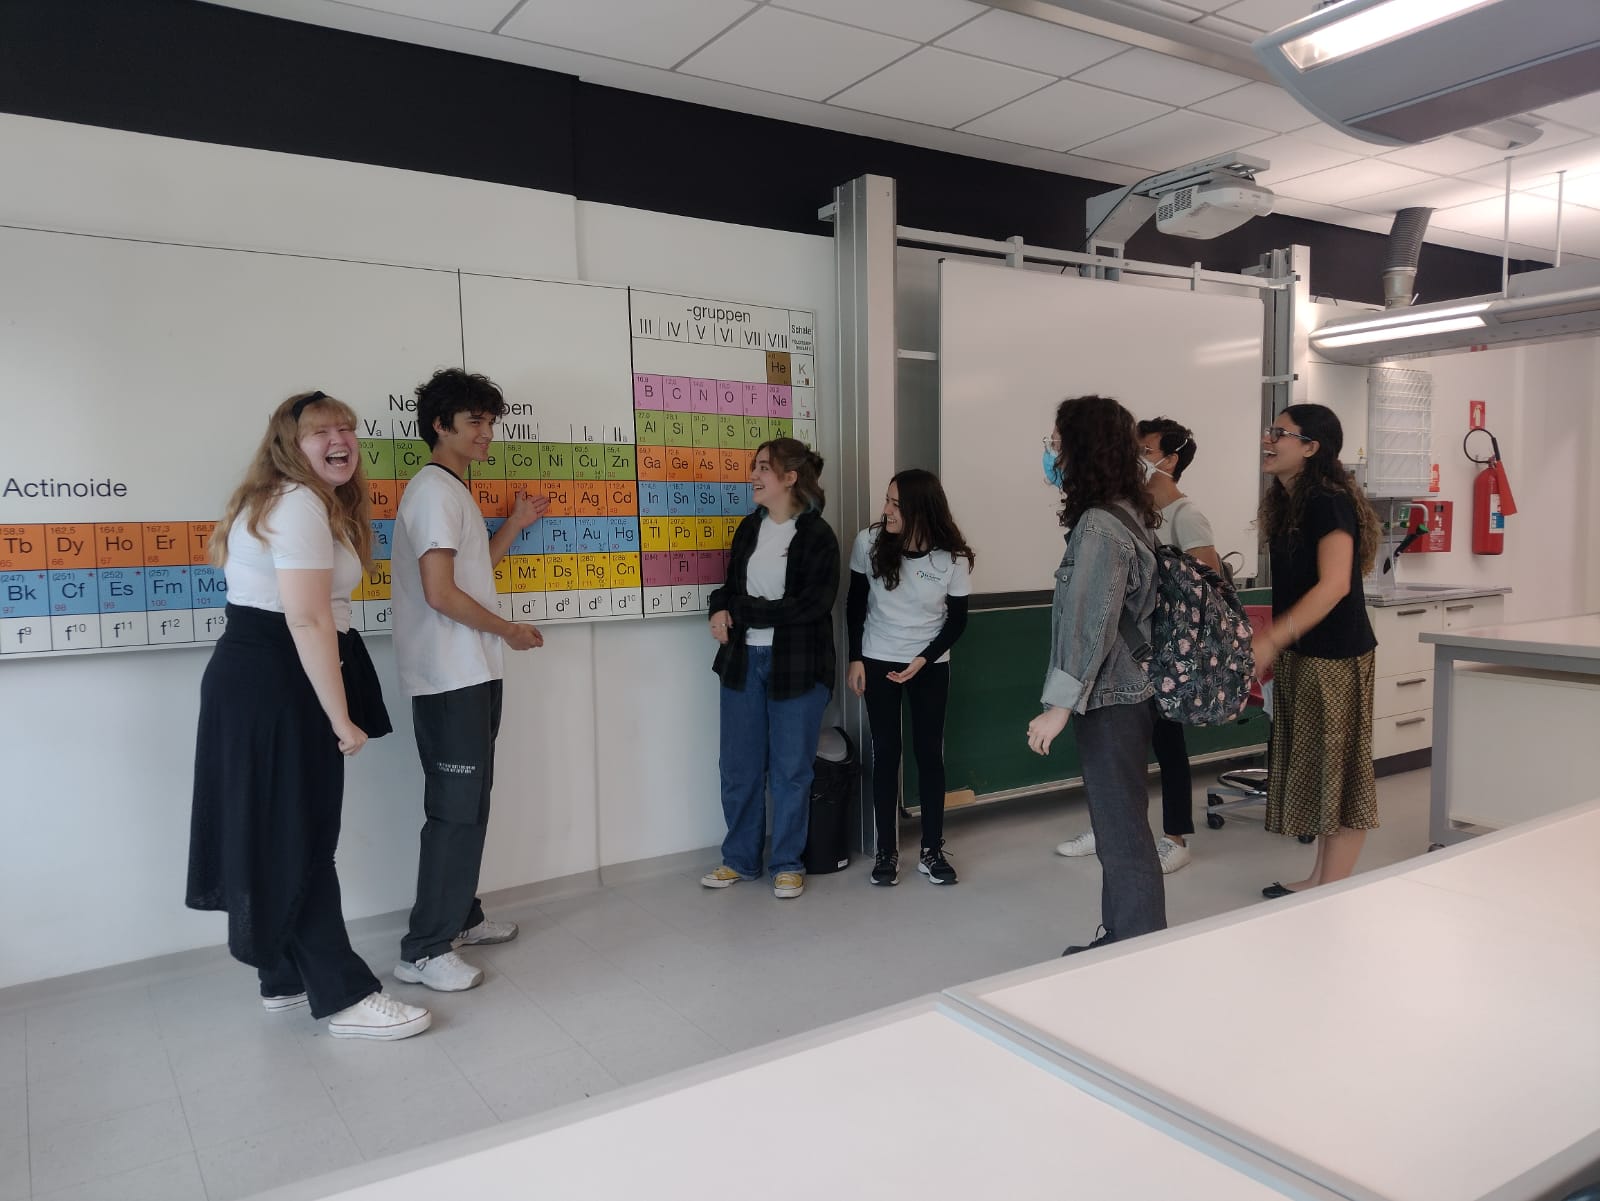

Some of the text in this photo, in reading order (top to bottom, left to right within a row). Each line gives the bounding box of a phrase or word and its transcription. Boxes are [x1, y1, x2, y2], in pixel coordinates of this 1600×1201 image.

[686, 305, 751, 324] -gruppen
[640, 319, 651, 335] III
[667, 321, 681, 337] IV
[696, 325, 706, 340] V
[791, 324, 812, 335] Schale
[720, 328, 733, 343] VI
[744, 331, 761, 346] VII
[768, 333, 788, 349] VIII
[772, 361, 786, 374] He
[799, 363, 806, 375] K
[645, 385, 653, 397] B
[672, 387, 681, 400] C
[700, 389, 708, 401] N
[725, 391, 734, 403] O
[752, 393, 758, 405] F
[773, 394, 787, 407] Ne
[645, 421, 656, 433] Al
[673, 422, 684, 435] Si
[701, 424, 709, 435] P
[727, 425, 735, 437] S
[750, 427, 761, 438] Cl
[776, 428, 786, 439] Ar
[368, 451, 380, 465] V
[403, 452, 422, 466] Cr
[512, 453, 533, 467] Co
[549, 454, 563, 467] Ni
[579, 454, 598, 468] Cu
[612, 455, 629, 468] Zn
[643, 456, 661, 469] Ga
[671, 457, 689, 470] Ge
[699, 458, 714, 470] As
[725, 458, 739, 471] Se
[2, 477, 128, 498] Actinoide
[479, 491, 498, 504] Ru
[548, 491, 567, 504] Pd
[581, 491, 599, 507] Ag
[613, 491, 631, 504] Cd
[648, 492, 659, 504] In
[673, 492, 689, 505] Sn
[700, 492, 716, 505] Sb
[726, 492, 740, 505] Te
[522, 528, 531, 541] Ir
[552, 529, 567, 542] Pt
[583, 527, 601, 540] Au
[615, 527, 634, 541] Hg
[649, 526, 660, 539] Tl
[675, 526, 691, 539] Pb
[704, 525, 715, 538] Bi
[3, 537, 33, 554] Tb
[57, 537, 84, 556] Dy
[106, 536, 133, 551] Ho
[156, 535, 176, 550] Er
[195, 534, 208, 549] T
[102, 570, 124, 579] (252)
[149, 569, 170, 578] (257)
[518, 566, 536, 579] Mt
[553, 565, 572, 578] Ds
[586, 563, 604, 579] Rg
[616, 562, 635, 575] Cn
[52, 572, 76, 581] (251)
[62, 582, 85, 599] Cf
[110, 581, 134, 597] Es
[153, 579, 183, 594] Fm
[198, 577, 227, 593] Md
[8, 585, 37, 601] Bk
[3, 606, 15, 614] 97
